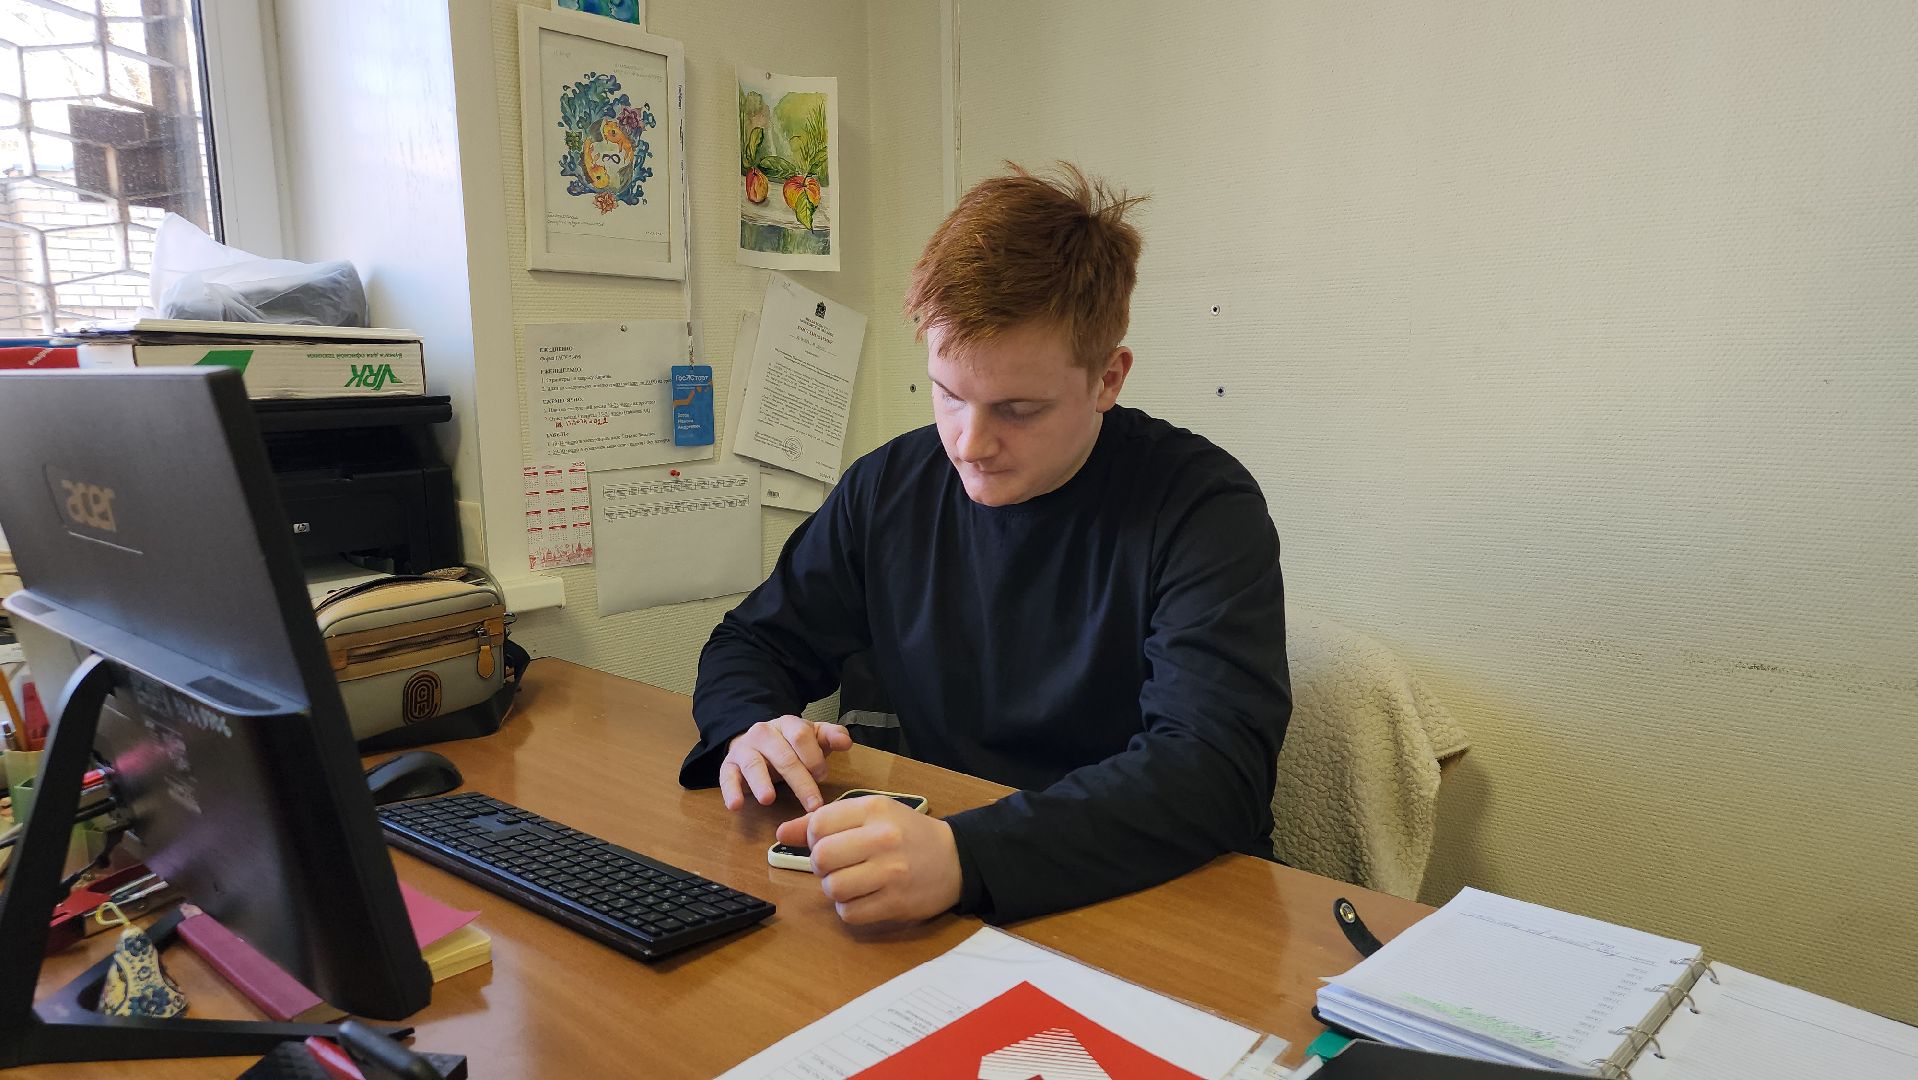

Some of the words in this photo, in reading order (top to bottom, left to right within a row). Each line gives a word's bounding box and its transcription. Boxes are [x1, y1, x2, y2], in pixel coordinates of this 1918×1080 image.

[336, 352, 366, 360] офисной
[366, 352, 379, 360] для
[343, 363, 404, 392] VRK
[61, 479, 116, 532] acer
